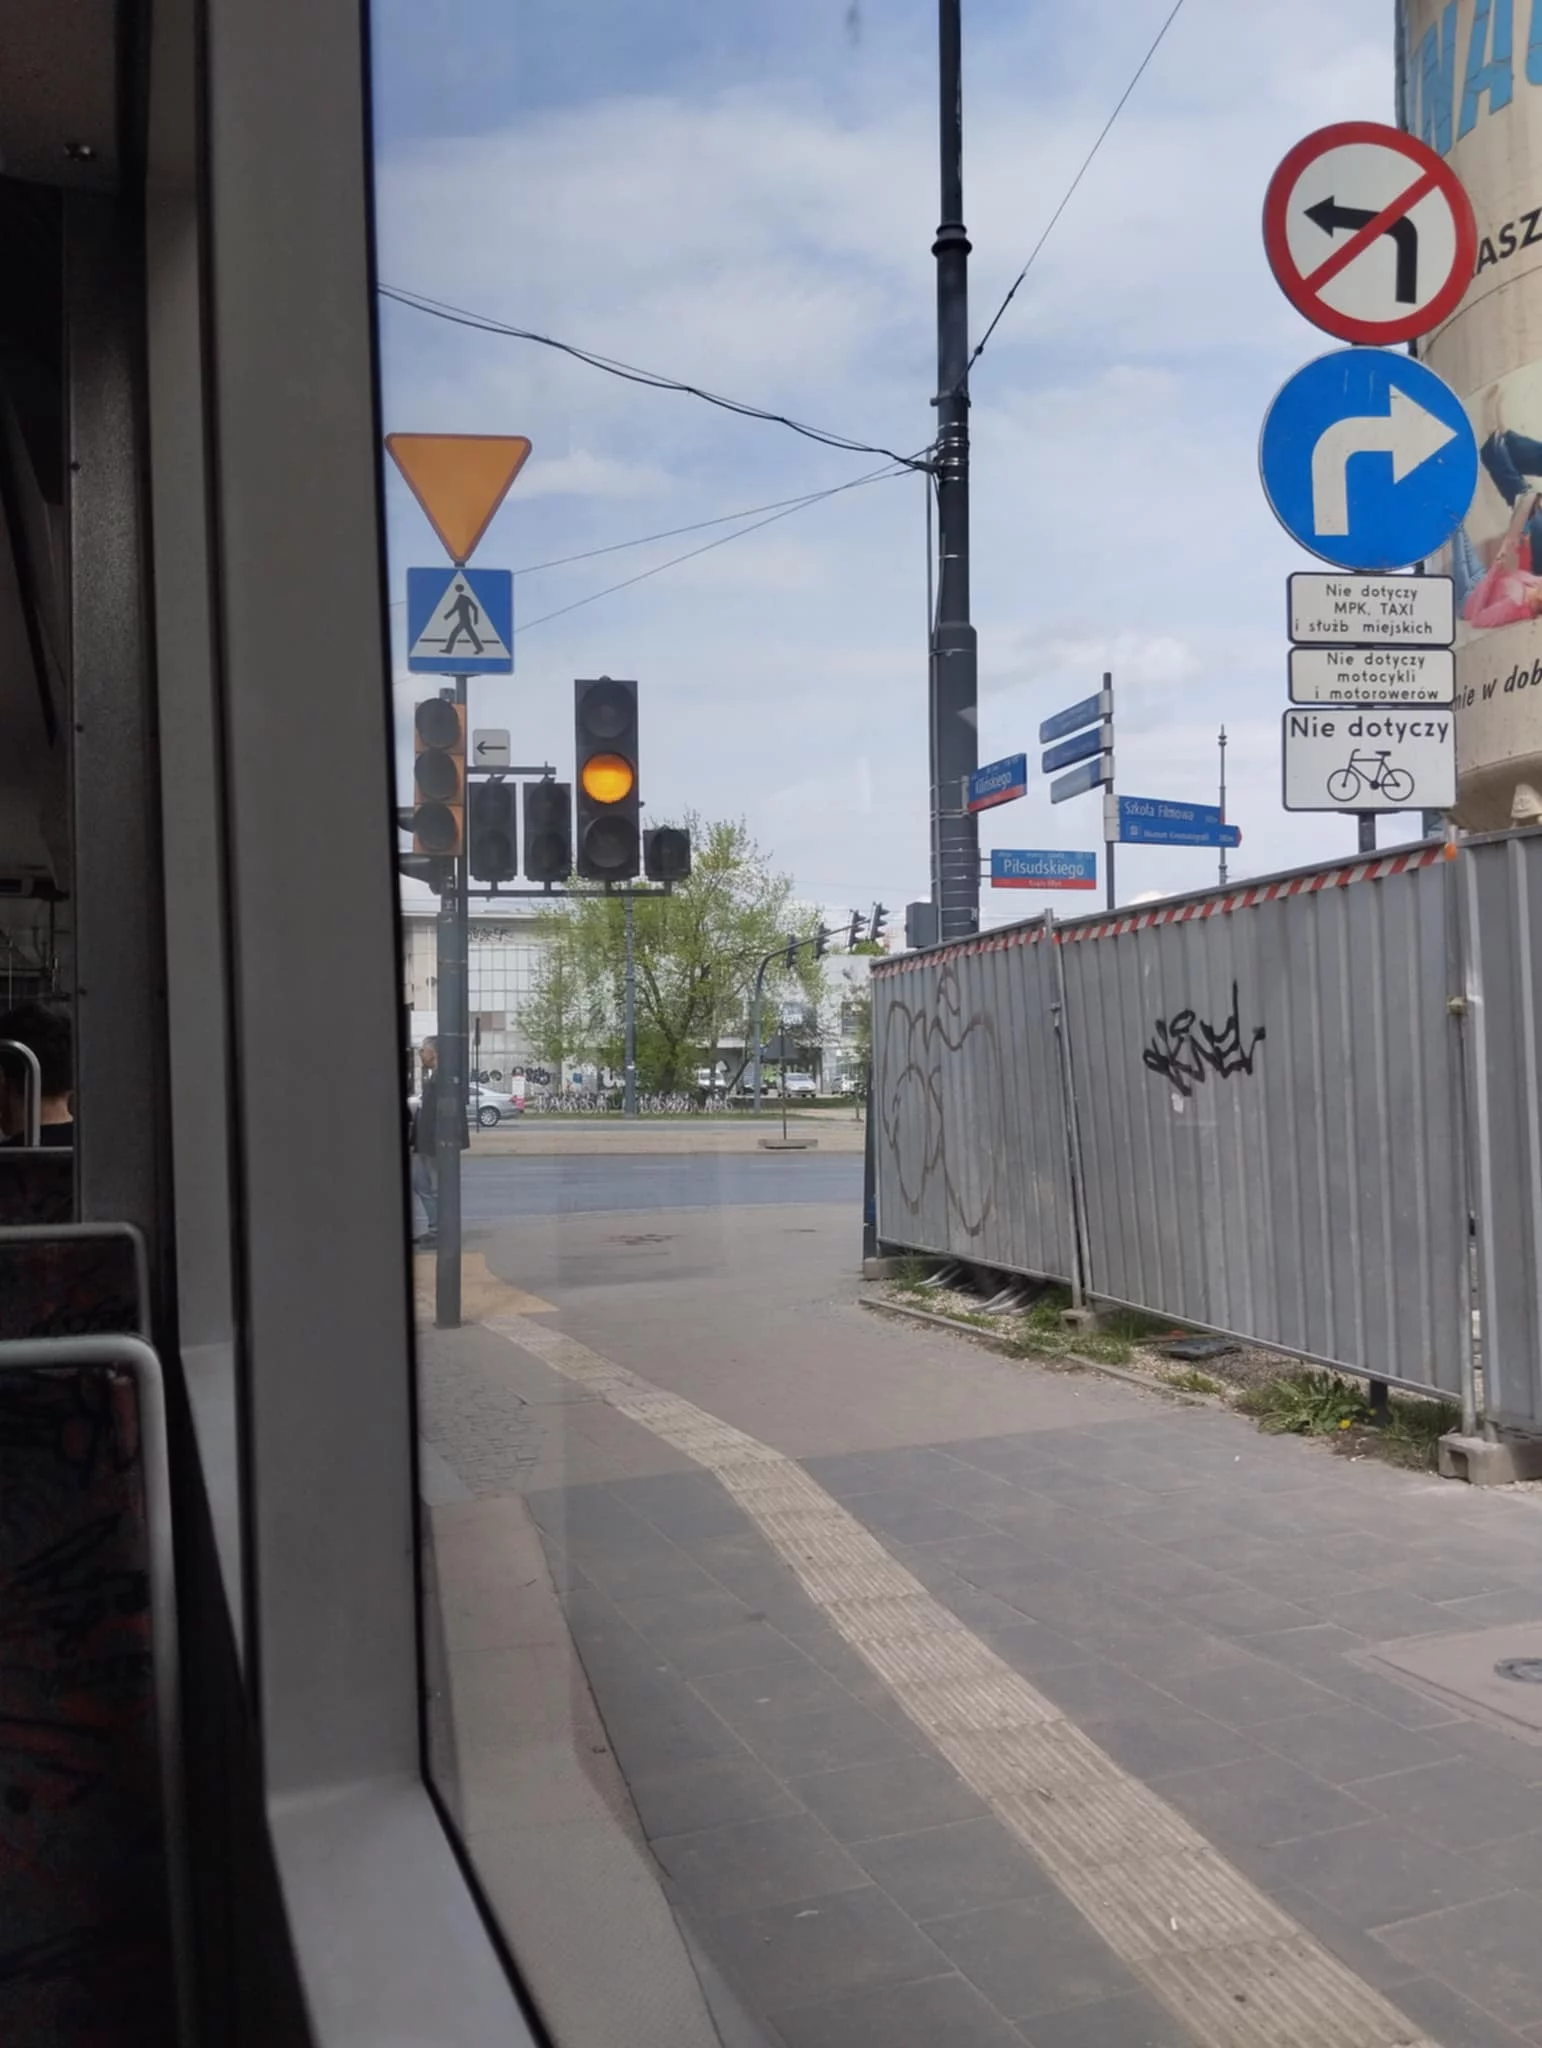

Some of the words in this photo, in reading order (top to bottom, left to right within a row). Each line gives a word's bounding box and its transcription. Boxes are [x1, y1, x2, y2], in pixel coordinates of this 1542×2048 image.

[1471, 206, 1542, 278] ASZ
[1326, 584, 1352, 597] Nie
[1361, 585, 1418, 601] dotyczy
[1380, 603, 1414, 616] TAXI
[1309, 619, 1349, 633] służb
[1362, 620, 1433, 636] miejskich
[1327, 652, 1354, 665] Nie
[1364, 652, 1425, 669] dotyczy
[1337, 670, 1415, 686] motocykli
[1329, 687, 1438, 700] motorowerów
[1482, 678, 1498, 701] w
[1290, 716, 1335, 738] Nie
[1348, 716, 1449, 744] dotyczy
[1124, 801, 1155, 817] Szkoła
[1158, 805, 1195, 821] Filmowa
[1003, 858, 1085, 879] Piłsudskiego
